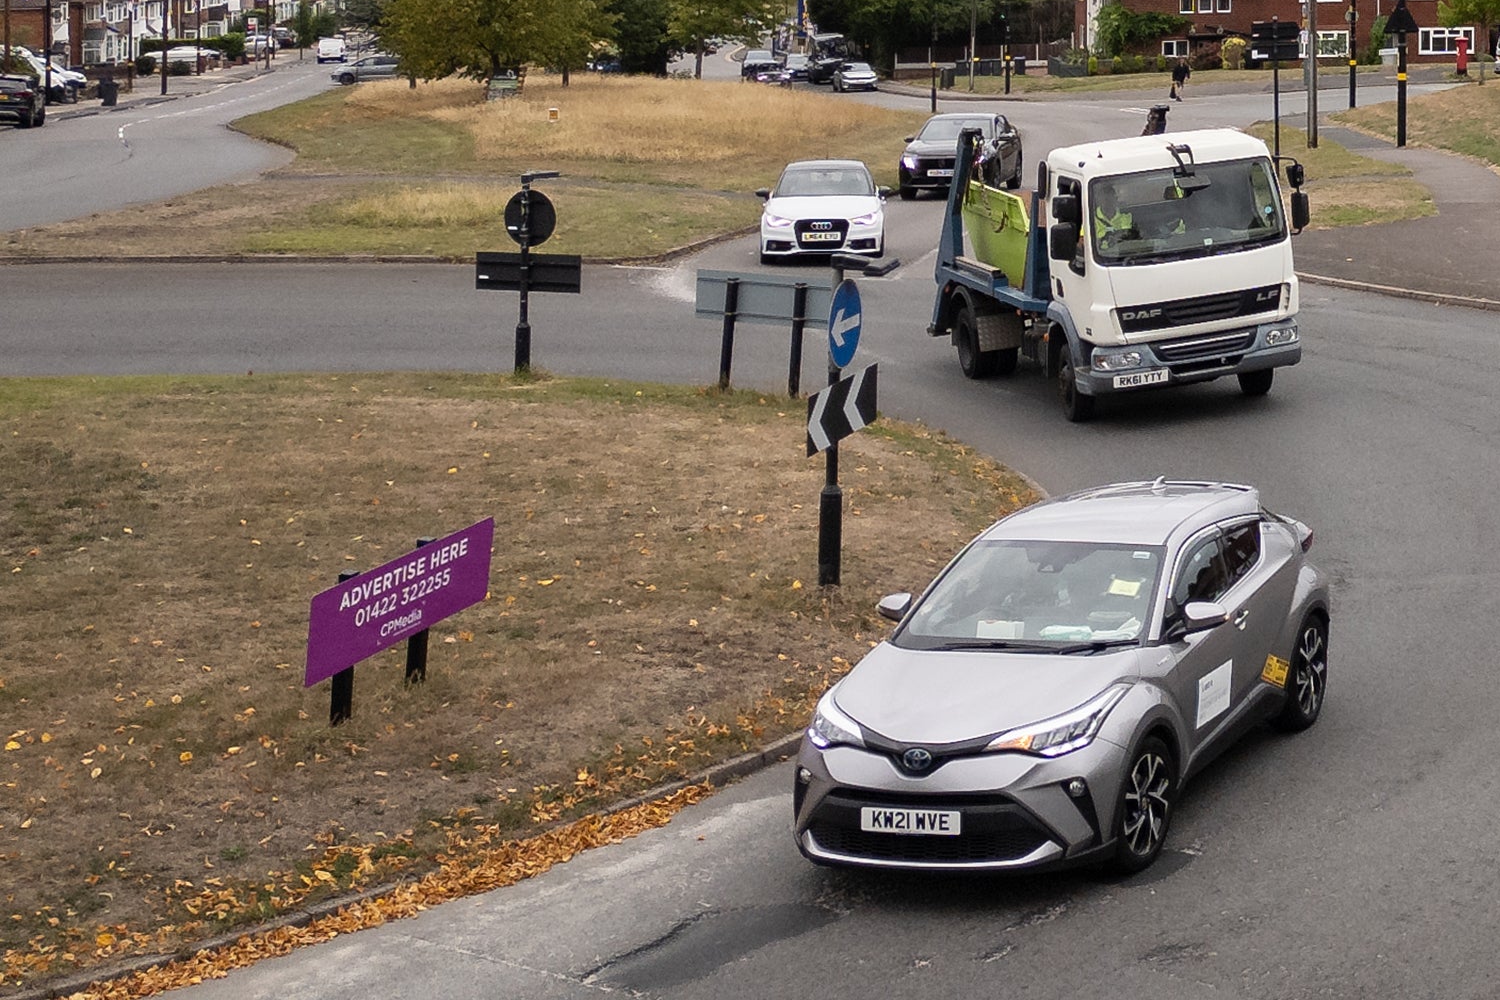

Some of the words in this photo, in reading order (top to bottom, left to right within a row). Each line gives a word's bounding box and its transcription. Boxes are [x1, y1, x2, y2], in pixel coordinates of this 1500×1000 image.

[1256, 289, 1279, 302] LF
[1122, 308, 1162, 321] DAF
[1119, 374, 1142, 386] RK61
[1144, 371, 1163, 383] YTY
[339, 557, 426, 611] ADVERTISE
[430, 538, 469, 570] HERE
[355, 593, 398, 627] 01422
[401, 568, 451, 606] 322255
[380, 608, 422, 637] CPMedia
[872, 810, 910, 829] KW21
[915, 812, 950, 831] WVE
